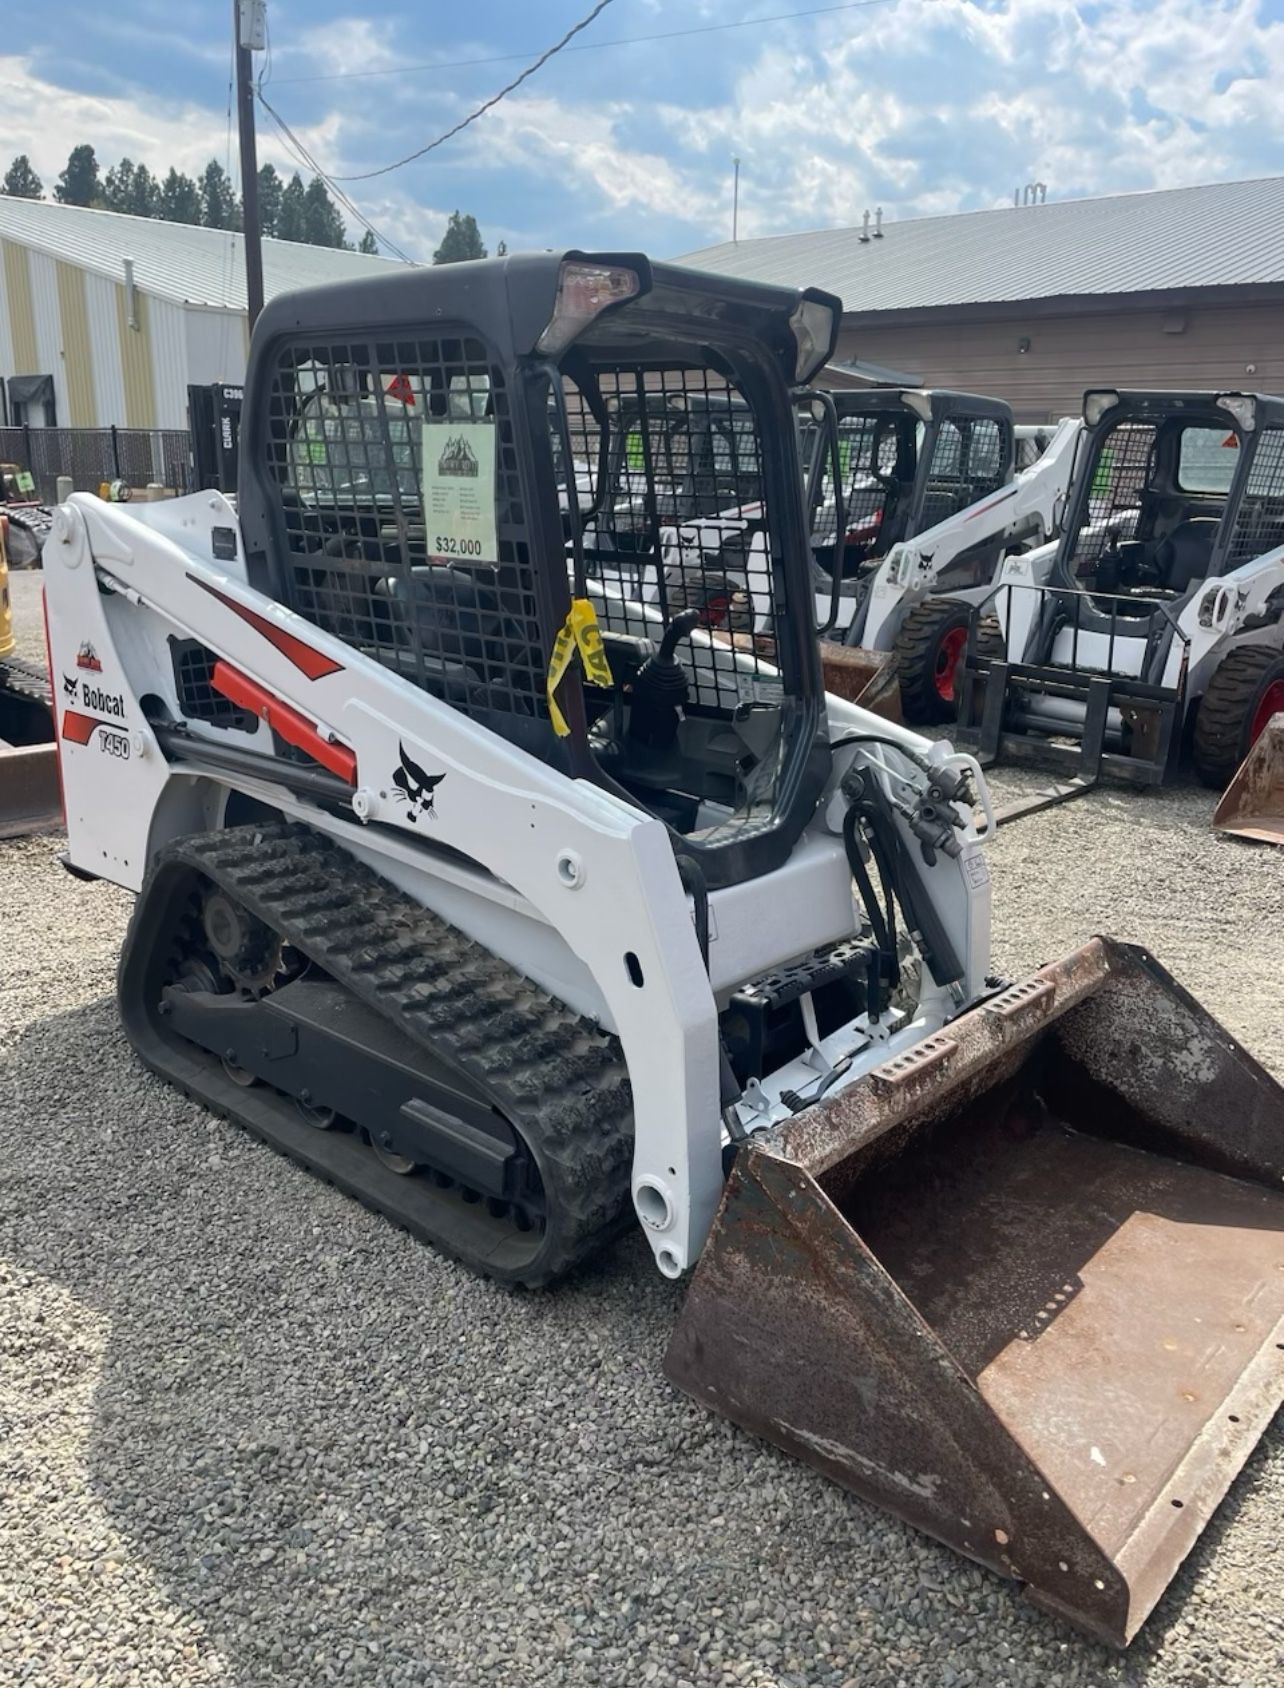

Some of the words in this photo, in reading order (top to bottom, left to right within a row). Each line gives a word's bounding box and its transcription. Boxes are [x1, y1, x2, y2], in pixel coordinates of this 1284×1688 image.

[222, 417, 233, 449] CLARK
[436, 536, 482, 556] $32,000
[82, 683, 125, 718] Bobcat
[98, 730, 130, 760] T450
